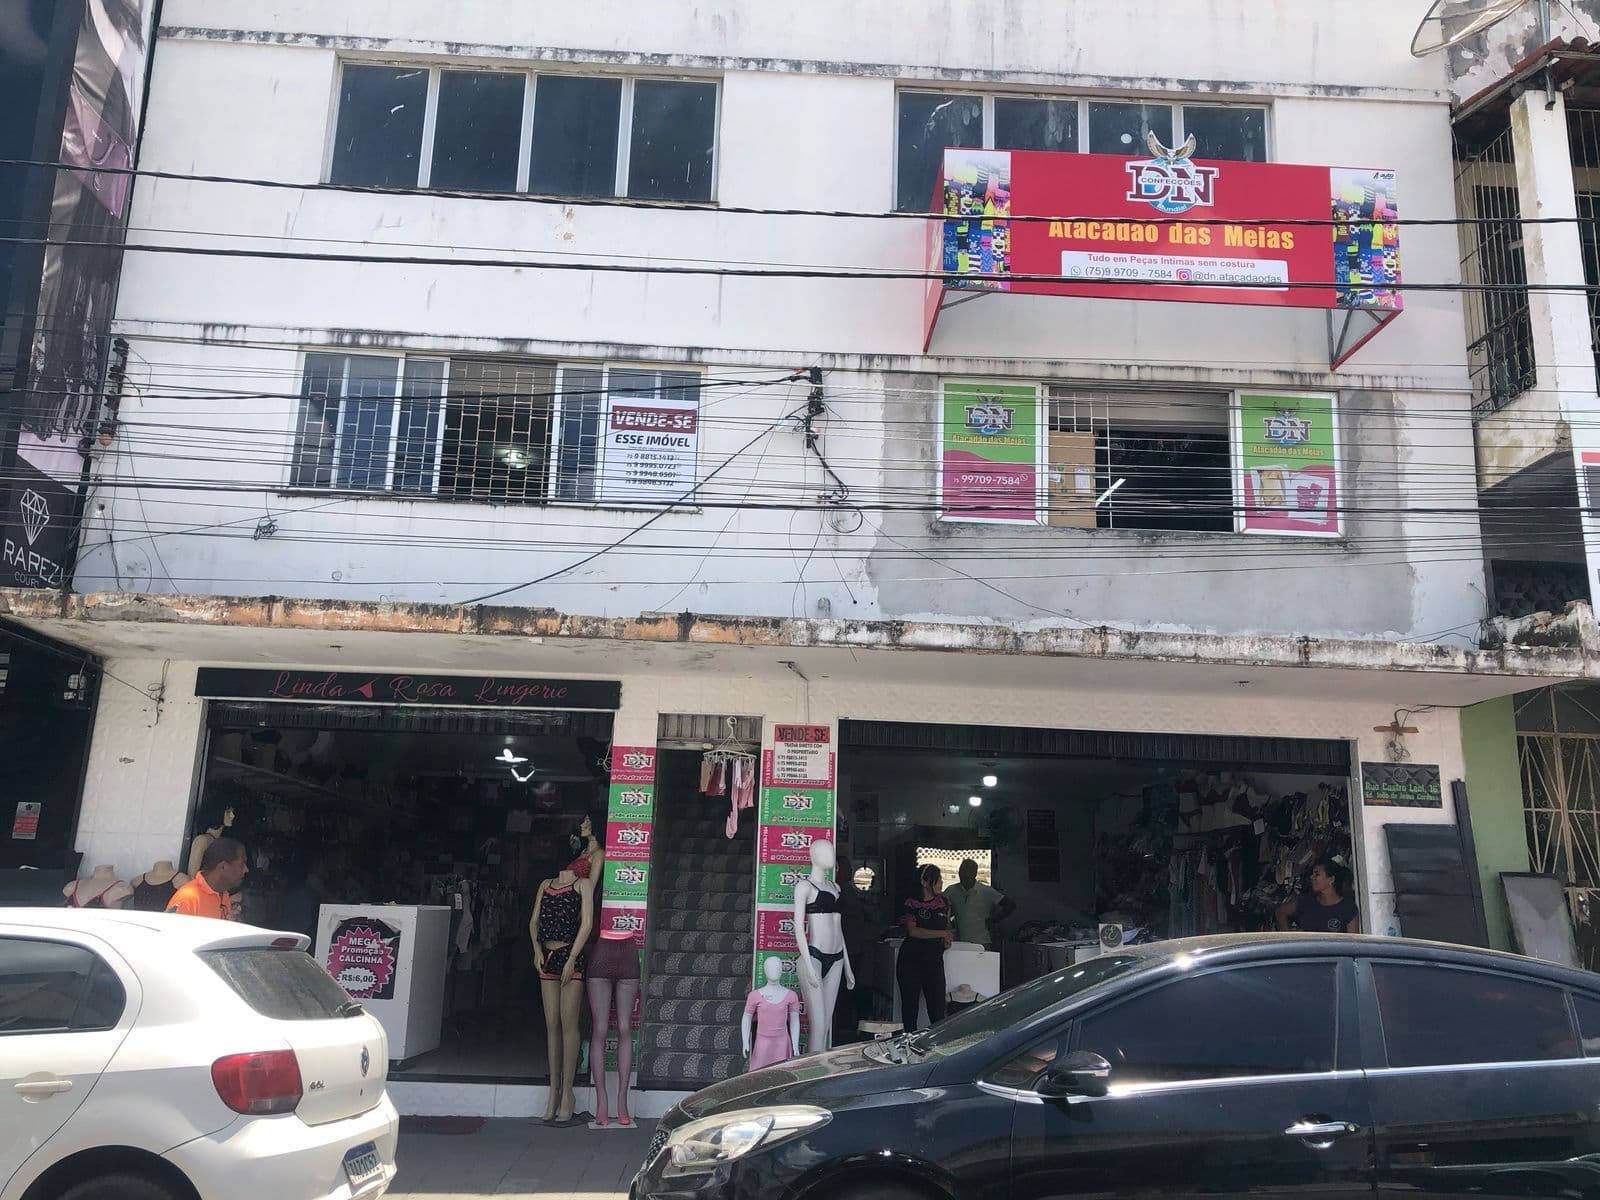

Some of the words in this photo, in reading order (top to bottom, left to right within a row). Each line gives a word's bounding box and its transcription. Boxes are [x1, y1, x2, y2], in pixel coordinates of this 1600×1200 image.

[1127, 162, 1218, 205] DN
[1169, 223, 1211, 245] das
[1224, 225, 1295, 250] Meias
[1088, 253, 1110, 262] Tudo
[1113, 255, 1127, 263] em
[1130, 255, 1158, 266] Peças
[1220, 260, 1256, 269] costura
[1148, 269, 1173, 279] 7584
[615, 410, 693, 429] VENDE-SE
[1263, 418, 1312, 441] DN
[615, 434, 644, 445] ESSE
[646, 433, 690, 448] IMÓVEL
[961, 474, 1020, 485] 99709-7584
[268, 671, 347, 698] Linda
[475, 678, 569, 705] Lingerie
[778, 727, 827, 742] VENDE-SE
[623, 754, 655, 767] DN
[1365, 781, 1380, 790] Rua
[620, 792, 653, 806] DN
[783, 796, 814, 809] DN
[618, 830, 650, 844] DN
[781, 833, 813, 847] DN
[615, 868, 647, 883] DN
[348, 937, 378, 947] MEGA
[338, 955, 384, 965] CALCINHA
